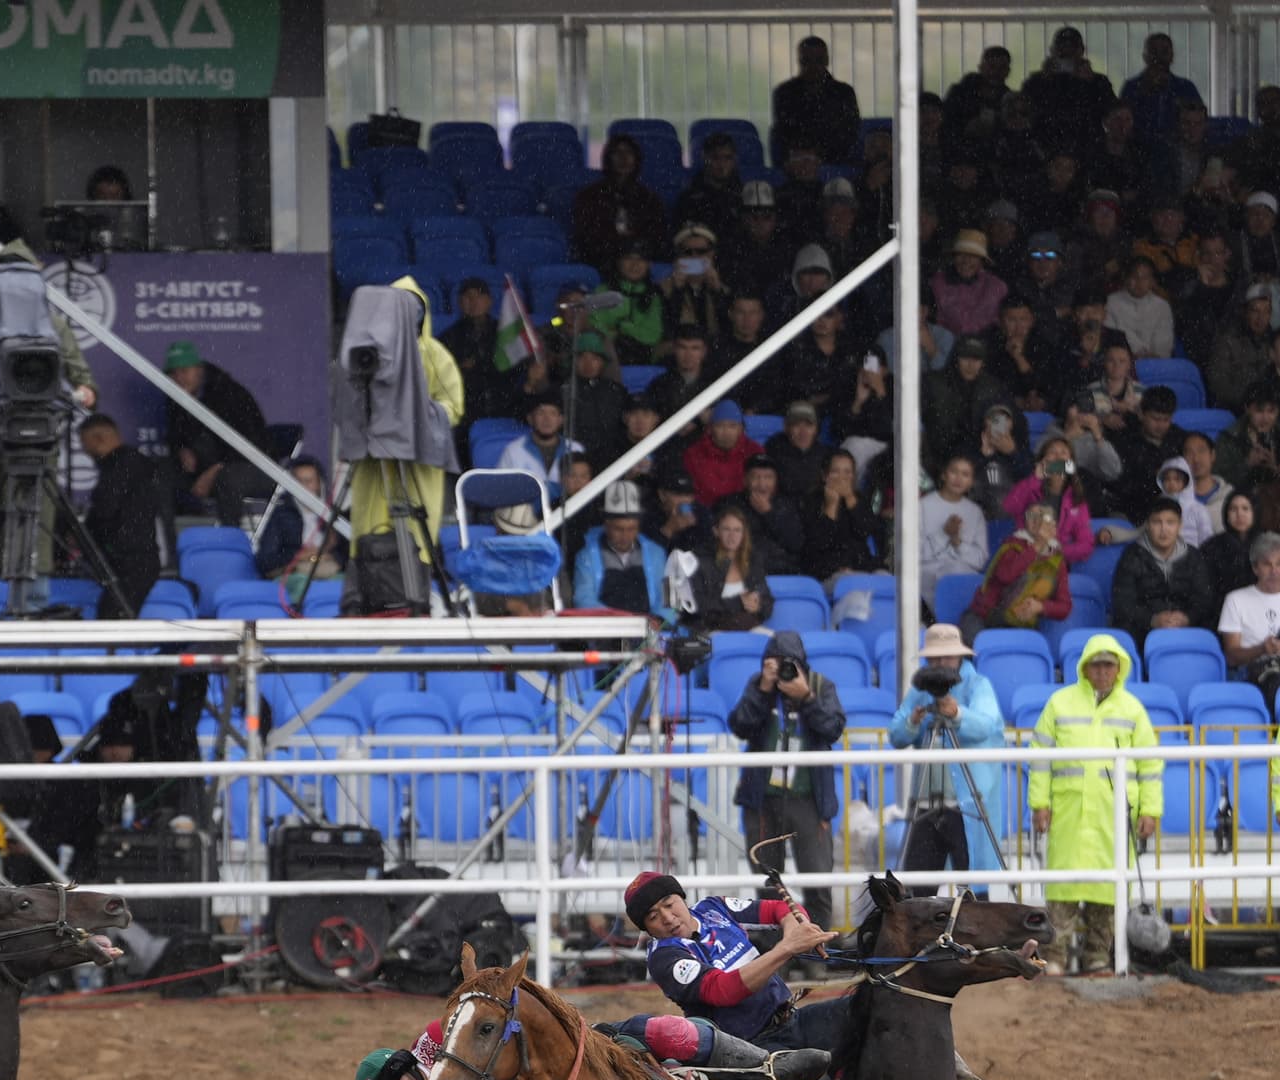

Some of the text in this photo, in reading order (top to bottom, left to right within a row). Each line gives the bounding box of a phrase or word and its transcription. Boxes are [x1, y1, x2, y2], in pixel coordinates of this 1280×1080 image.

[87, 63, 235, 91] nomadtv.kg
[135, 281, 243, 298] 31-АВГУСТ
[135, 302, 263, 318] 6-СЕНТЯБРЬ
